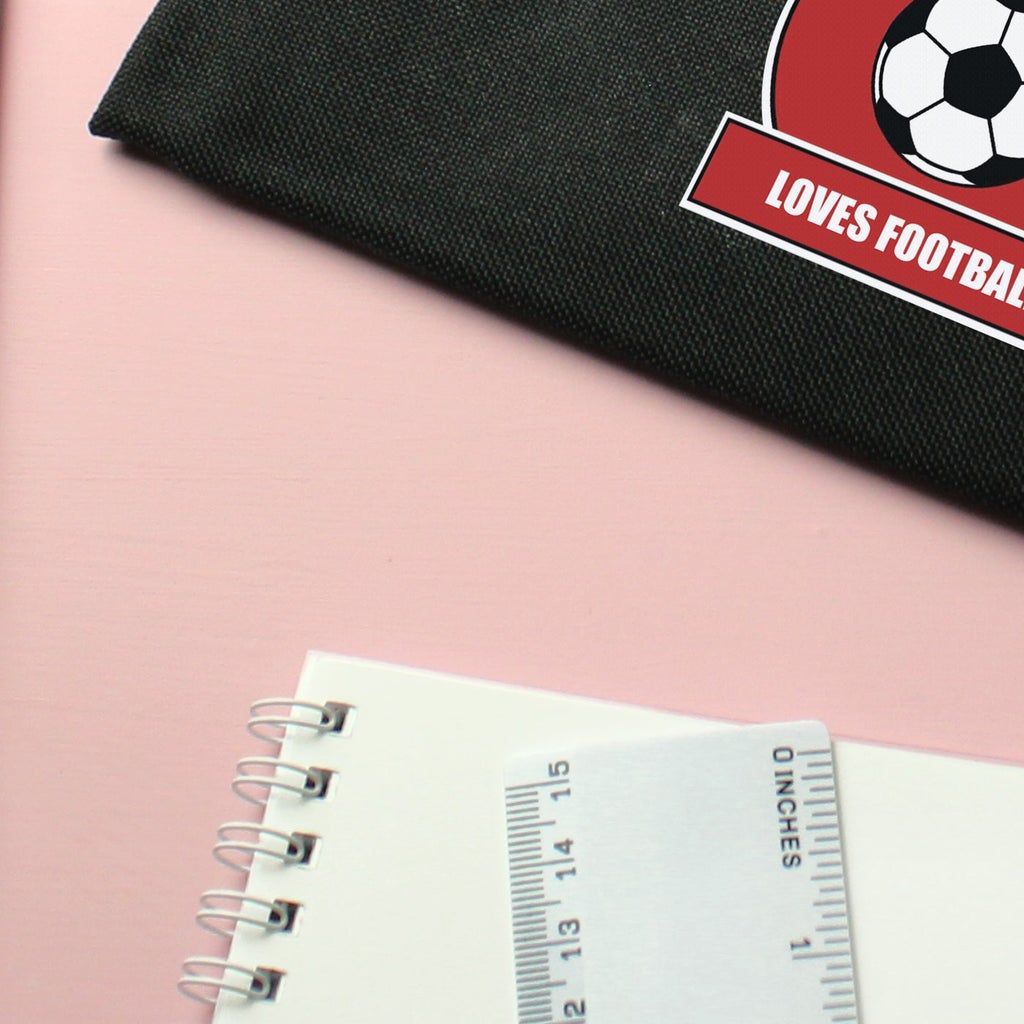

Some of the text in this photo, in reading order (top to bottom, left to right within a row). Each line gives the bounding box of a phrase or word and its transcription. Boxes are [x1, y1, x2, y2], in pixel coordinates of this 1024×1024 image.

[764, 169, 878, 243] LOVES
[774, 769, 802, 869] INCHES
[789, 938, 812, 951] 1
